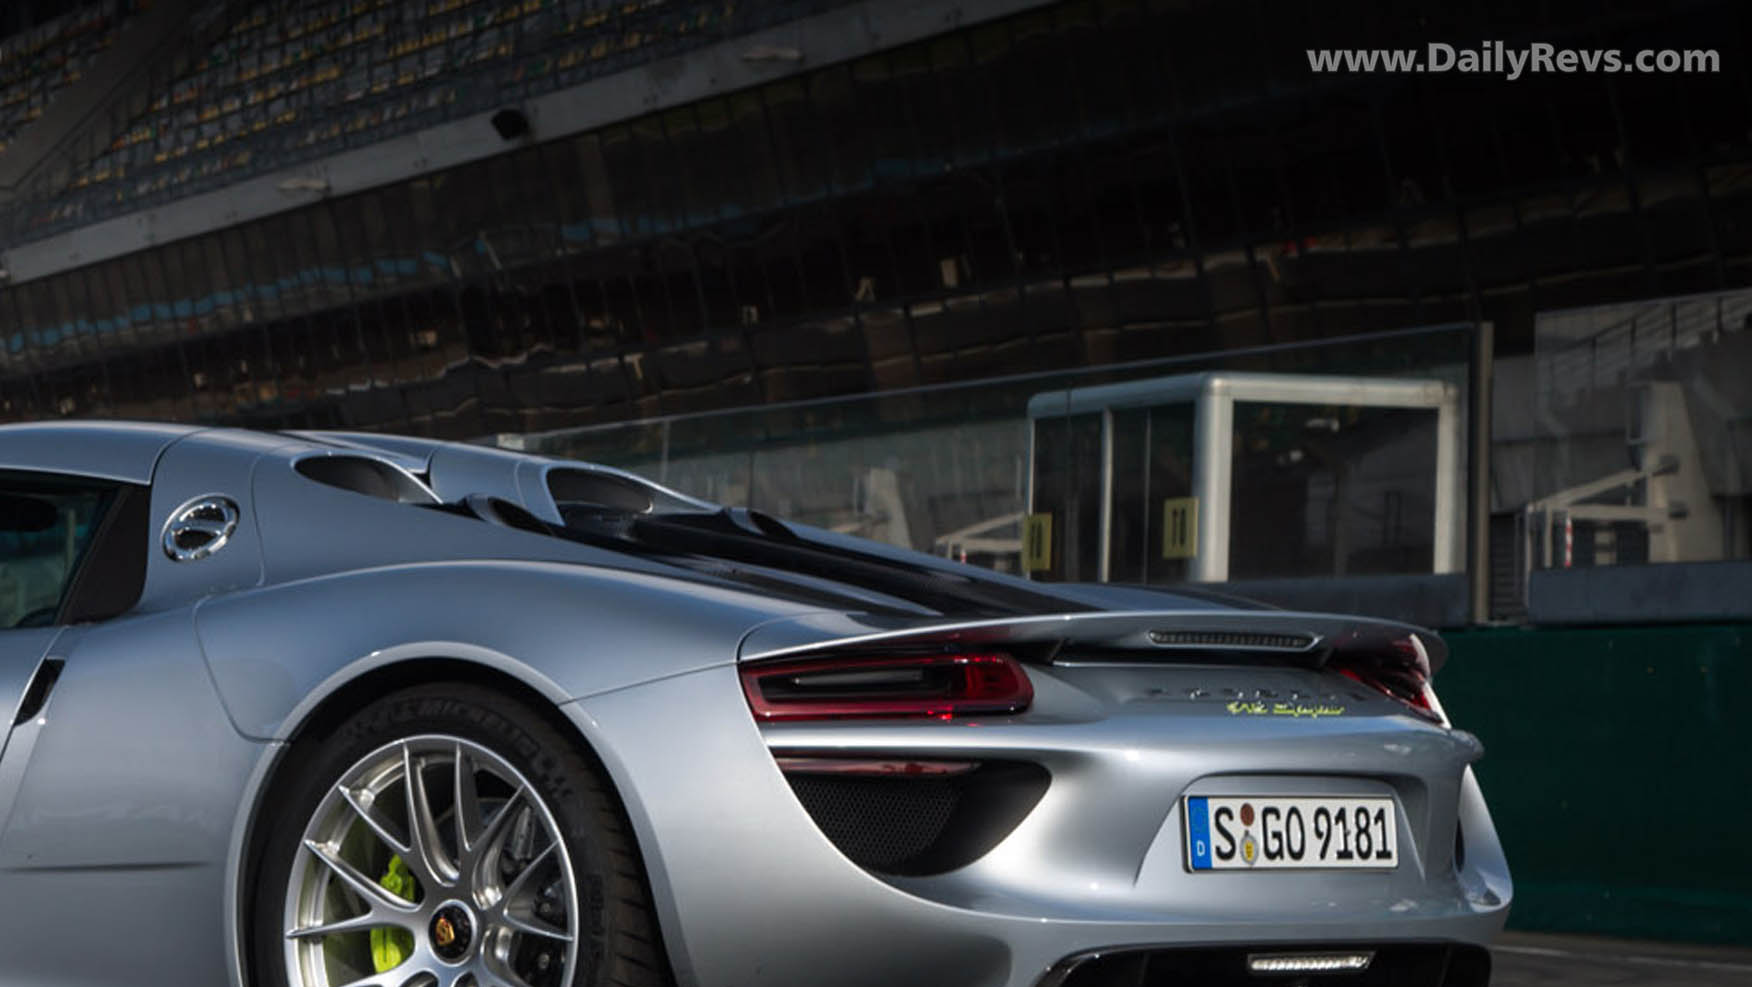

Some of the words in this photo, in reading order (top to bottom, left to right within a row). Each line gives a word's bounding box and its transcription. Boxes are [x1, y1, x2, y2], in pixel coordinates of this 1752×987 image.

[1197, 841, 1206, 857] D
[1214, 806, 1236, 861] S
[1261, 805, 1306, 861] GO
[1313, 805, 1393, 861] 9181
